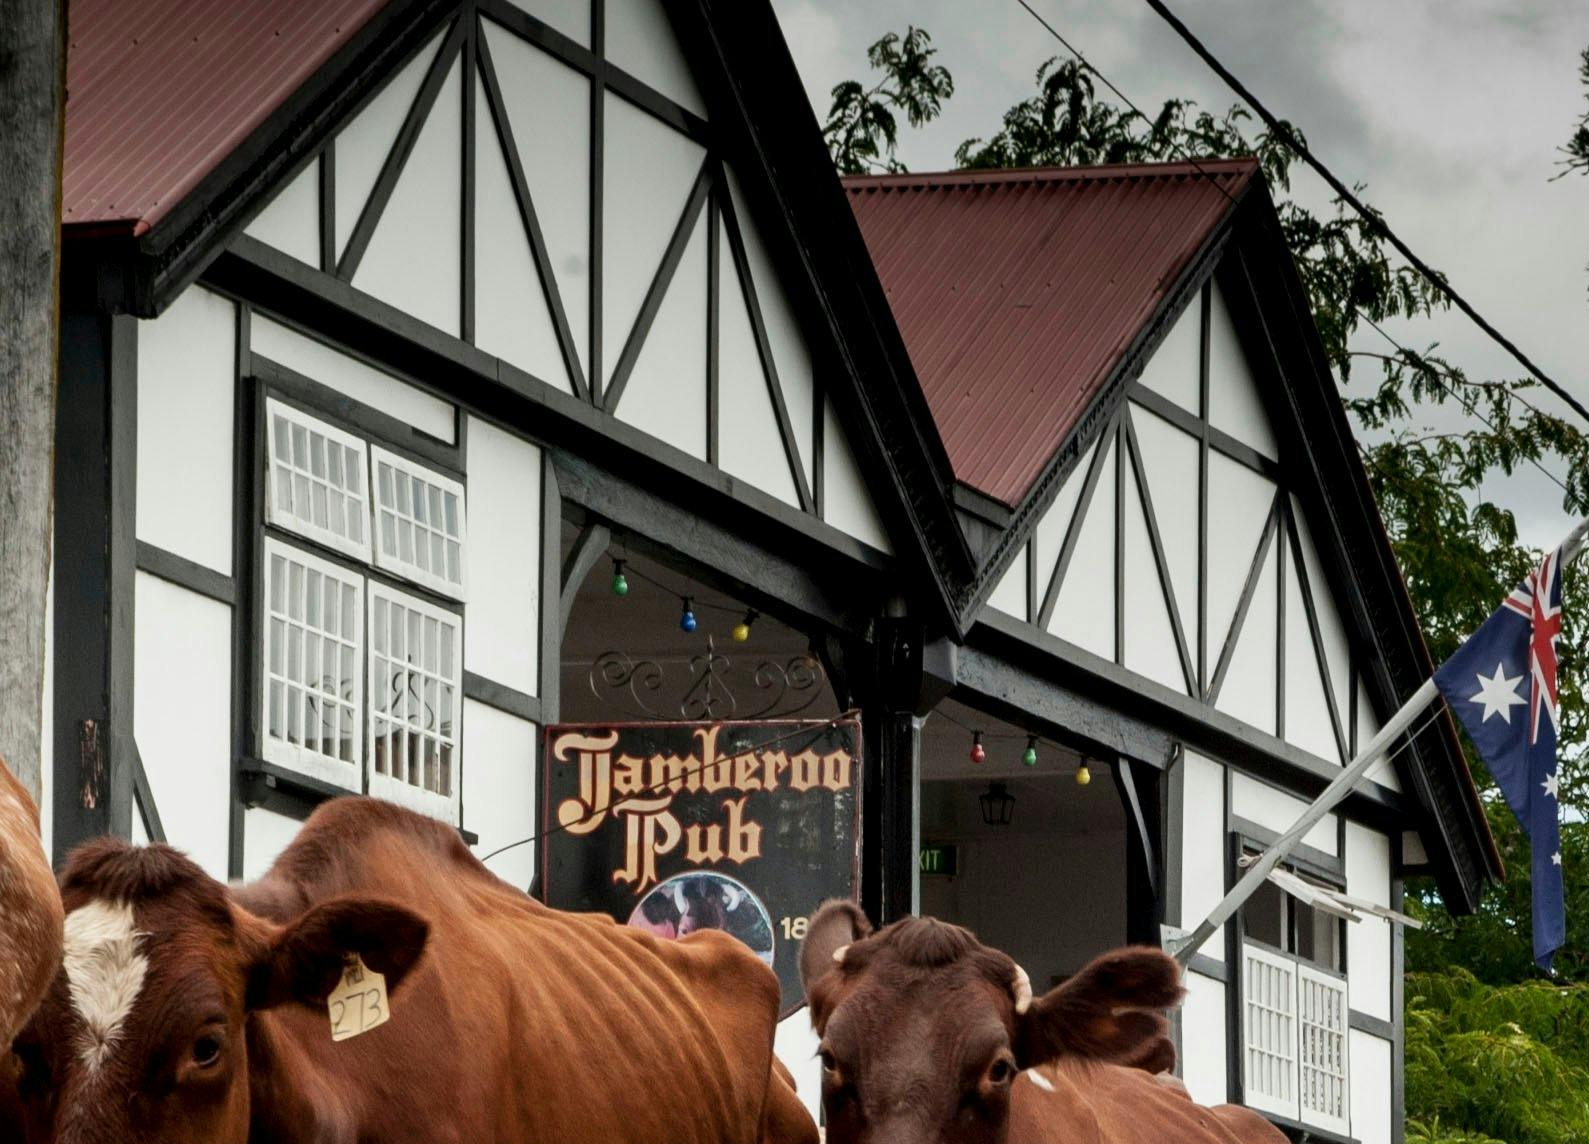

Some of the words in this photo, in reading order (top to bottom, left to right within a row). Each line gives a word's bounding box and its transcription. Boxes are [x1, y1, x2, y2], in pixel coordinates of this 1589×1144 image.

[554, 726, 851, 834] Jamberoo
[613, 797, 763, 894] Pub
[780, 916, 809, 940] 18
[331, 987, 382, 1036] 273
